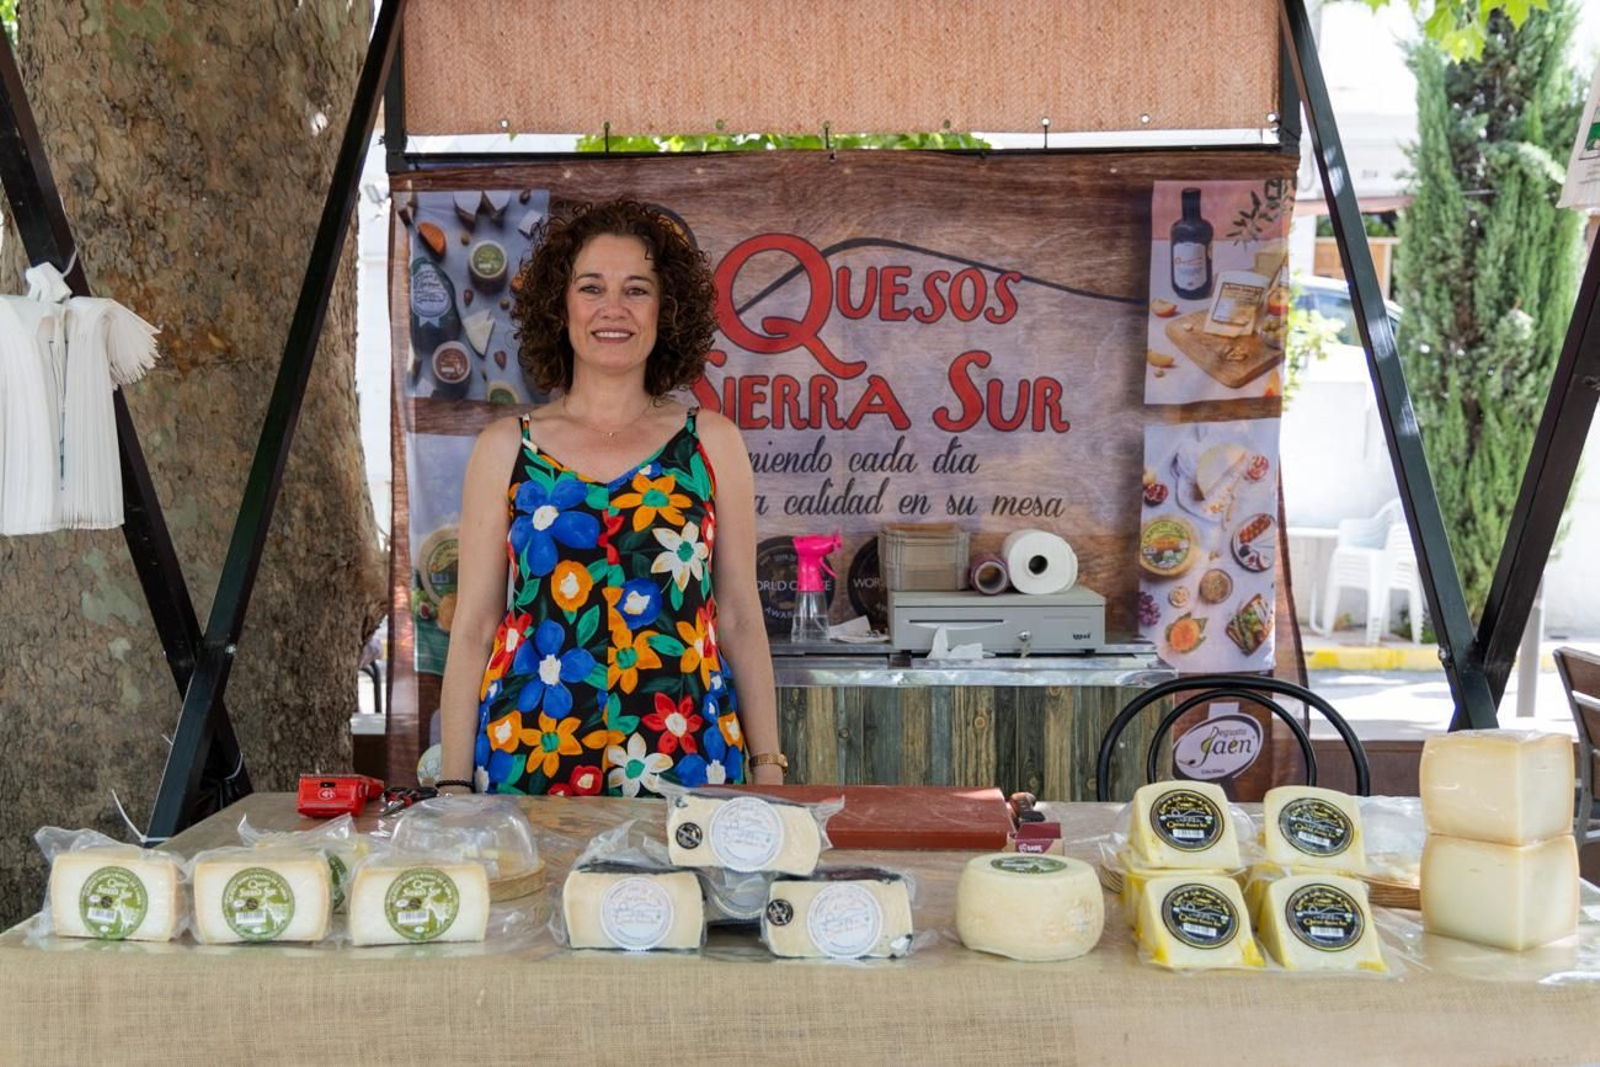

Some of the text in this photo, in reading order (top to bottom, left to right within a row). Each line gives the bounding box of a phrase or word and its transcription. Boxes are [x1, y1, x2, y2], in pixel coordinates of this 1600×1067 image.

[748, 435, 981, 473] niendo cada día
[784, 477, 891, 516] calidad
[898, 494, 931, 515] en
[946, 494, 978, 515] su
[991, 494, 1066, 517] mesa
[757, 580, 787, 591] ORLD
[853, 578, 880, 588] WOR
